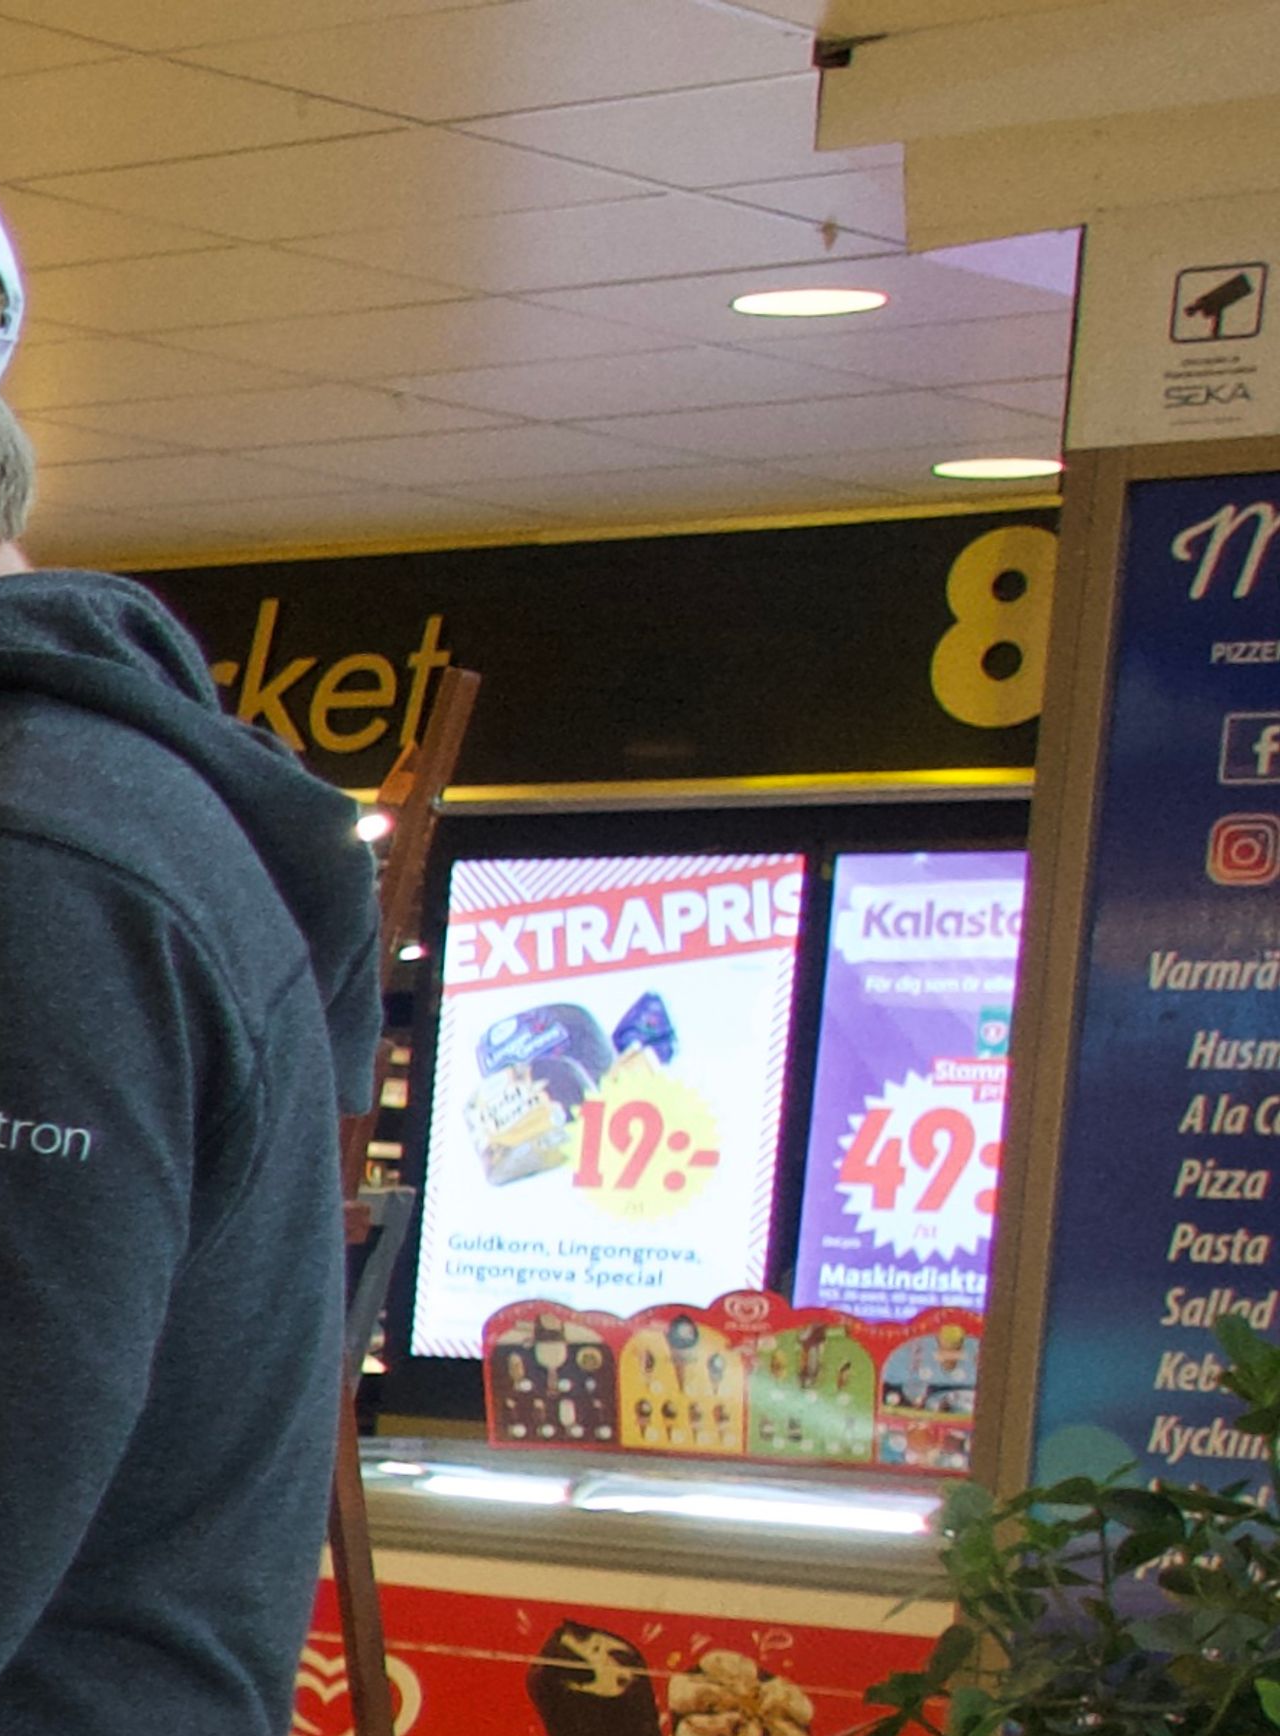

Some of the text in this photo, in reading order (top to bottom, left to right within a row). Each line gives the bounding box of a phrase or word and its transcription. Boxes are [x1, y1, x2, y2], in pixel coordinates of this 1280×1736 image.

[212, 597, 452, 752] ket
[443, 872, 801, 985] EXTRAPRIS
[1173, 1158, 1271, 1201] Pizza
[1167, 1221, 1272, 1266] Pasta
[445, 1259, 664, 1288] Lingongrova Special
[1154, 1350, 1238, 1395] Keb
